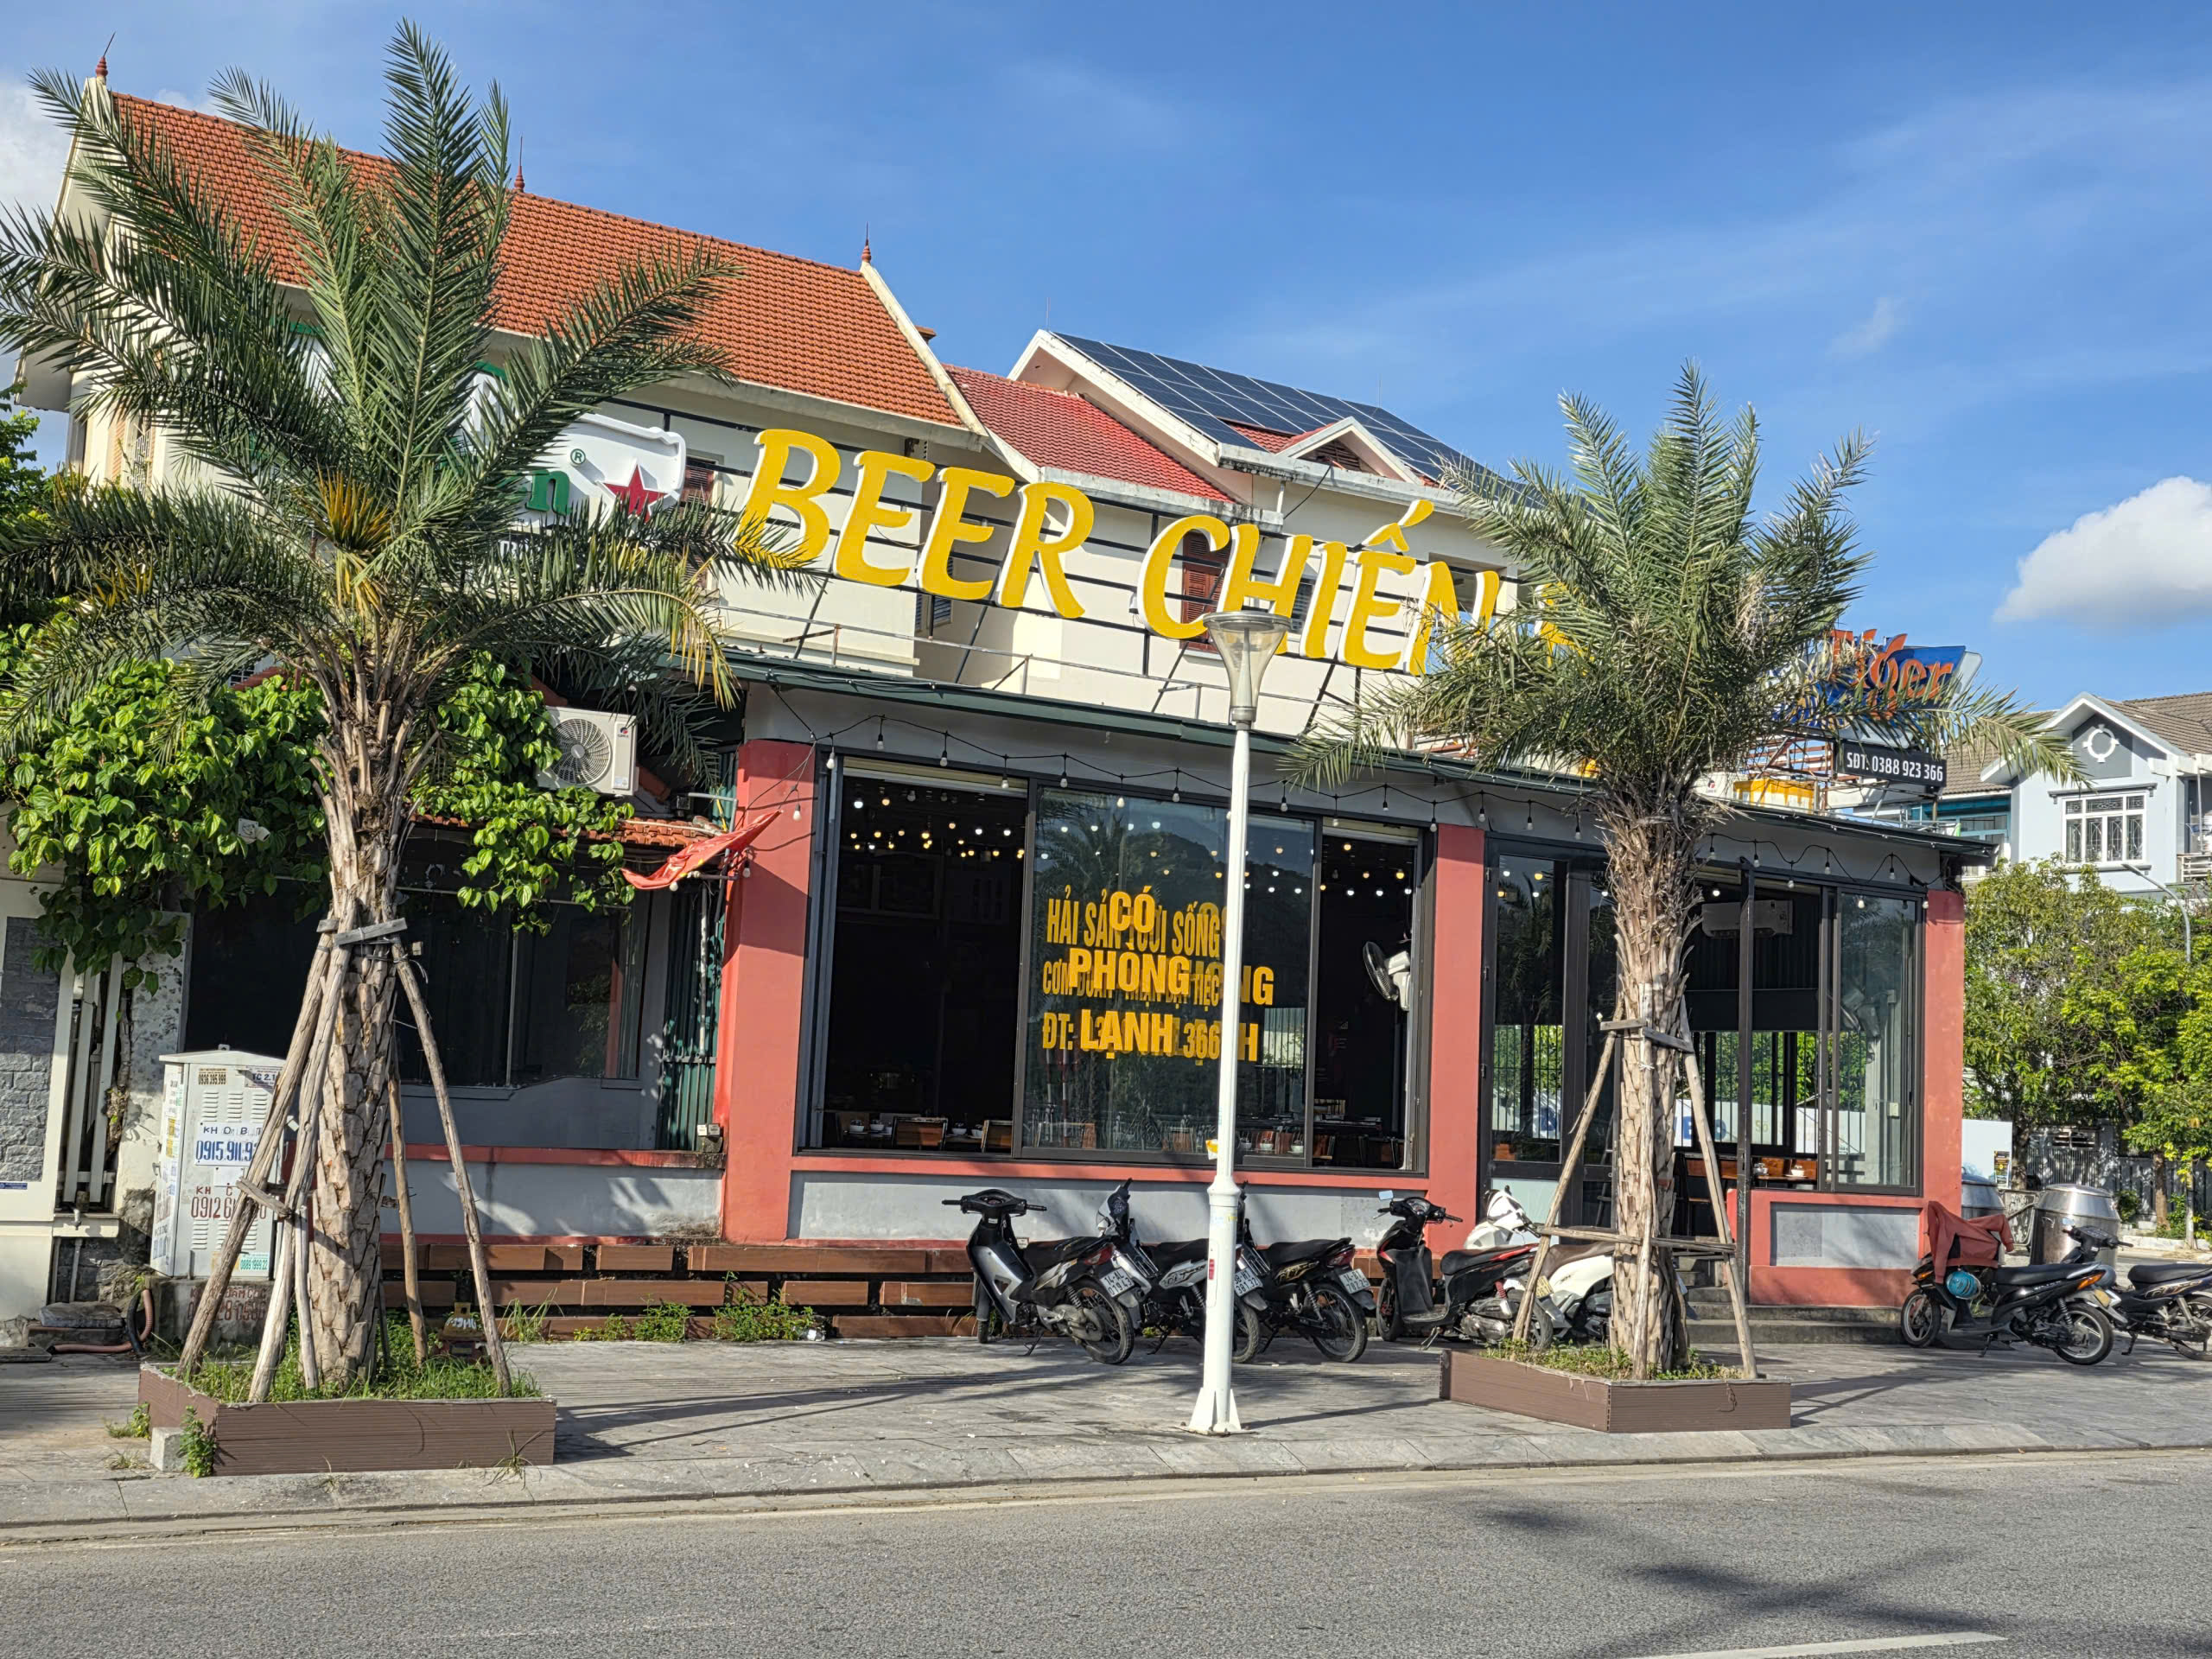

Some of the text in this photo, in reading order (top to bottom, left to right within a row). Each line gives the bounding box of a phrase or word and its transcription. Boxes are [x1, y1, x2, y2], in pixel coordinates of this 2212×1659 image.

[738, 429, 1095, 620] BEER
[1872, 755, 1900, 775] 0388
[1903, 760, 1922, 778] 923
[1923, 764, 1943, 782] 366
[1046, 885, 1079, 945] HẢI
[1172, 901, 1220, 959] SỐNG
[1109, 885, 1156, 934] CÓ
[1069, 942, 1191, 995] PHÒNG
[1042, 1012, 1074, 1050] ĐT:
[1183, 1022, 1221, 1060] 366
[1080, 1008, 1173, 1059] LẠNH
